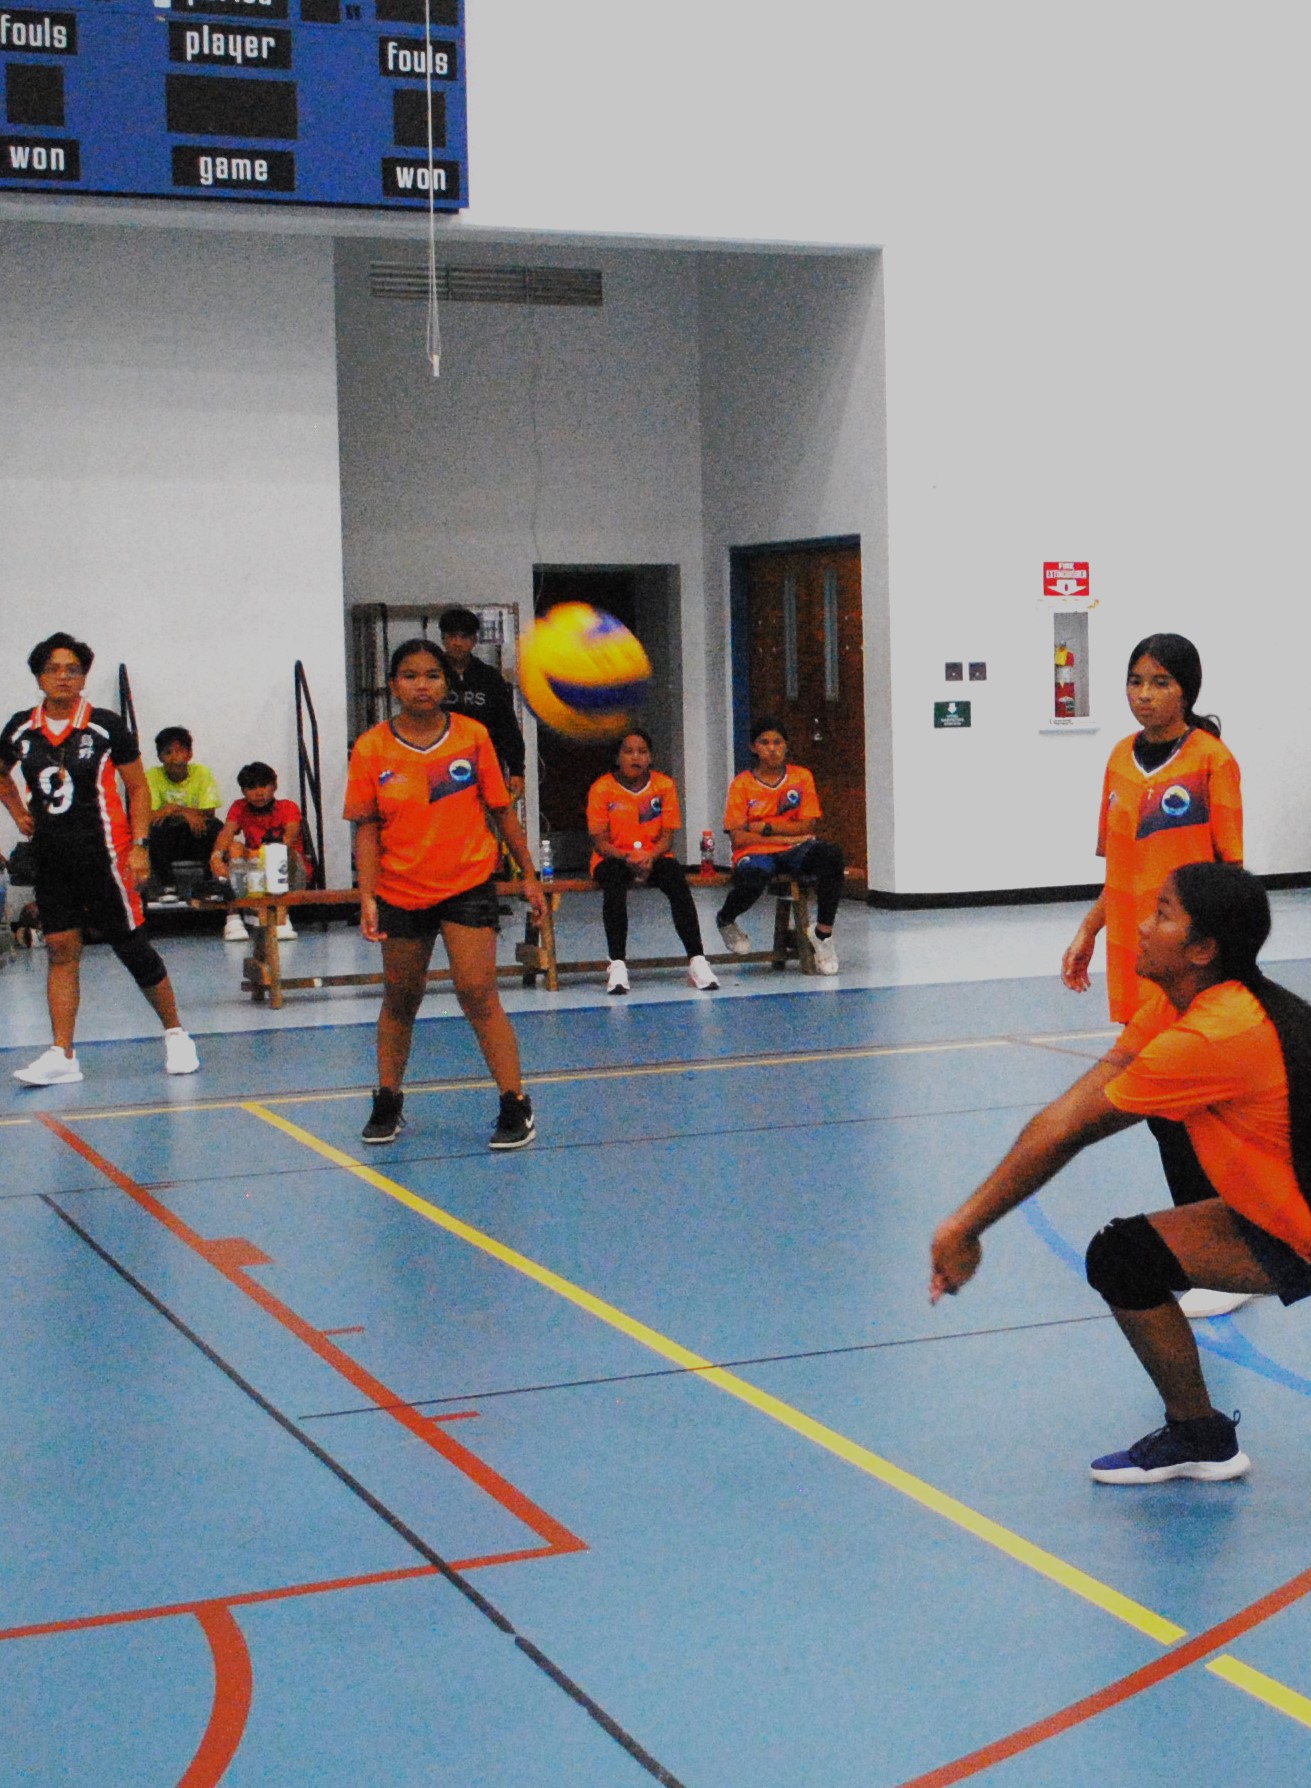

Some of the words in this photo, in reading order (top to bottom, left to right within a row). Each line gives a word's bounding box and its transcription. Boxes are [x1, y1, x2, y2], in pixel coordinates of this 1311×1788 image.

[0, 14, 68, 48] fouls
[185, 24, 276, 64] player
[387, 41, 449, 75] fouls
[9, 144, 65, 172] won
[199, 155, 269, 186] game
[395, 165, 447, 192] won
[38, 766, 74, 814] 9
